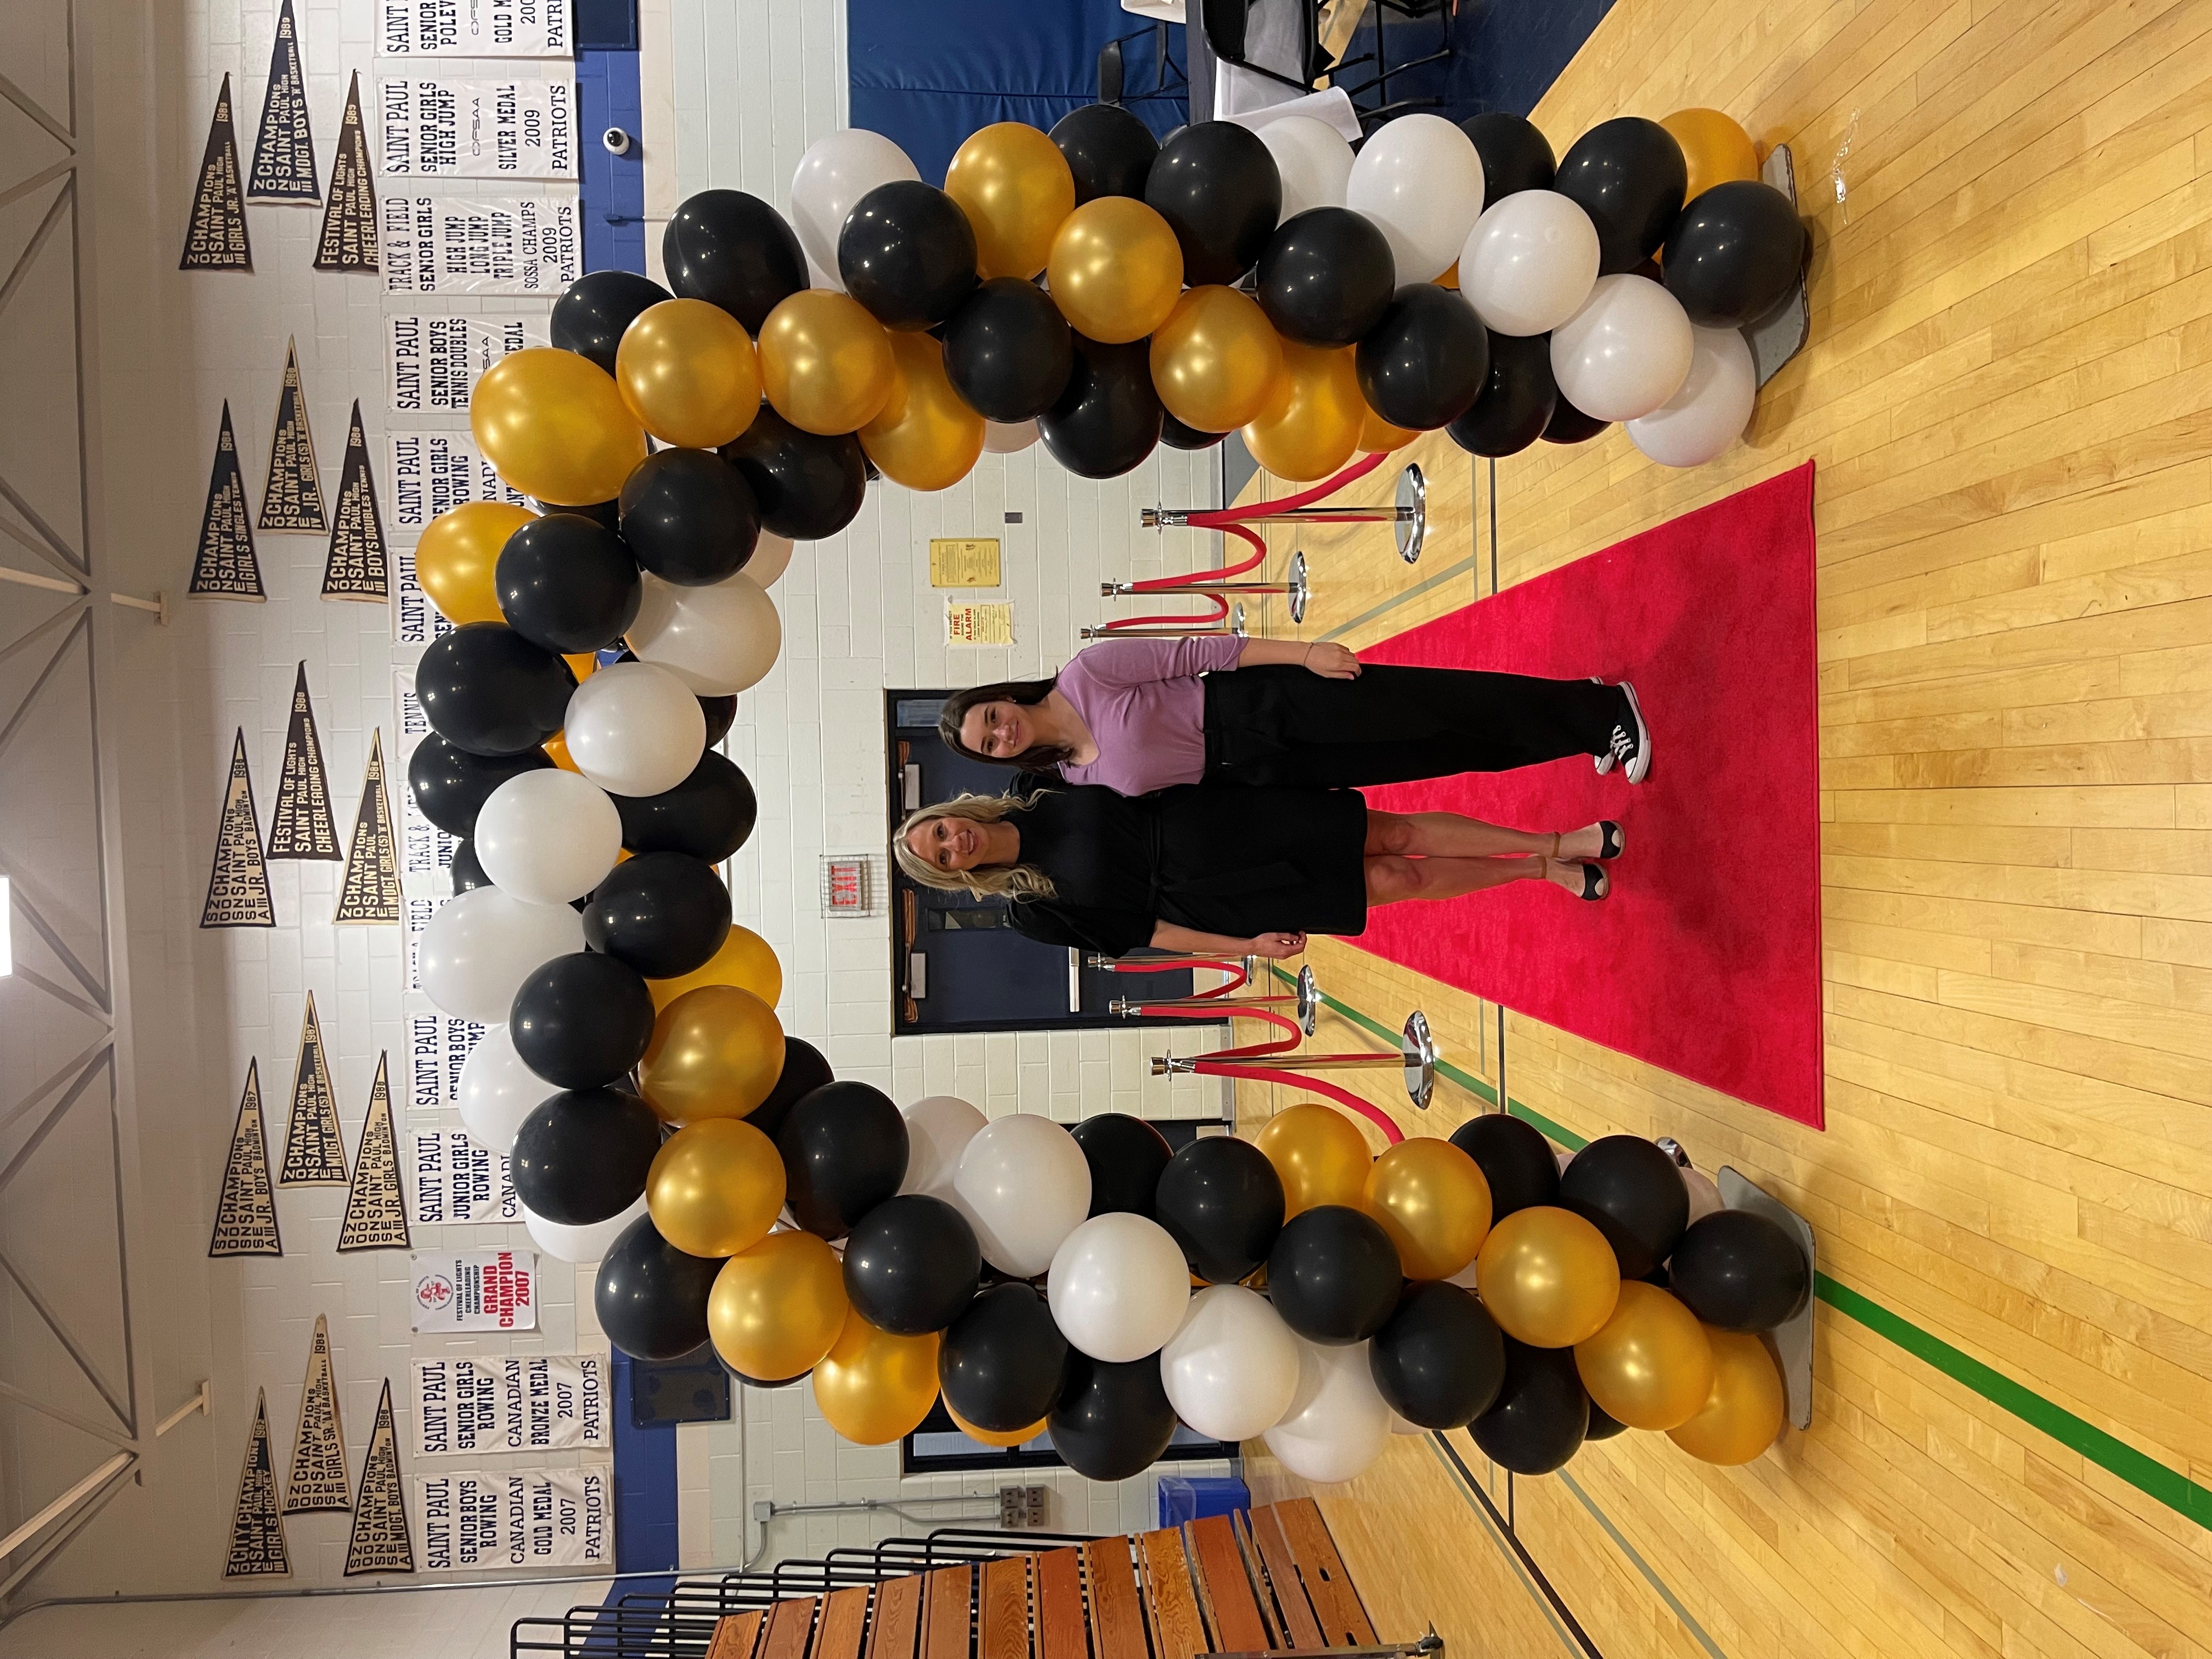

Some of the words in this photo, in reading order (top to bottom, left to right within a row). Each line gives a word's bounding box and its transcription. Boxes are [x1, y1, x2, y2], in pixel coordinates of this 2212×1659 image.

[386, 6, 410, 53] SAINT
[420, 3, 438, 49] SENIOR
[494, 14, 512, 43] GOLD
[279, 97, 290, 123] PAUL
[292, 98, 308, 139] BOYS
[386, 81, 409, 121] PAUL
[419, 83, 437, 120] GIRLS
[438, 90, 455, 126] JUMP
[496, 85, 516, 124] MEDAL
[257, 84, 281, 176] CHAMPIONS
[439, 130, 456, 165] HIGH
[524, 110, 540, 146] 2009
[550, 86, 568, 170] PATRIOTS
[275, 129, 291, 177] SAINT
[386, 126, 410, 172] SAINT
[420, 125, 438, 172] SENIOR
[498, 131, 517, 170] SILVER
[335, 154, 347, 185] LIGHTS
[191, 164, 216, 251] CHAMPIONS
[212, 178, 223, 202] PAUL
[332, 188, 343, 201] OF
[345, 190, 356, 215] PAUL
[208, 207, 224, 251] SAINT
[227, 218, 245, 251] GIRLS
[321, 204, 343, 263] FESTIVAL
[358, 178, 378, 266] CHEERLEADING
[386, 198, 410, 232] FIELD
[416, 198, 432, 238] GIRLS
[445, 216, 465, 242] JUMP
[469, 216, 489, 242] JUMP
[492, 212, 512, 239] JUMP
[521, 202, 537, 255] CHAMPS
[342, 219, 359, 264] SAINT
[446, 247, 467, 273] HIGH
[469, 247, 490, 274] LONG
[492, 242, 513, 279] TRIPLE
[542, 227, 557, 263] 2009
[558, 207, 574, 282] PATRIOTS
[387, 253, 412, 290] TRACK
[419, 241, 435, 291] SENIOR
[524, 259, 538, 289] SOSSA
[396, 318, 419, 357] PAUL
[430, 321, 448, 354] BOYS
[449, 319, 467, 368] DOUBLES
[397, 362, 420, 409] SAINT
[431, 358, 448, 405] SENIOR
[450, 370, 469, 409] TENNIS
[266, 430, 286, 514] CHAMPIONS
[286, 442, 296, 467] PAUL
[397, 437, 420, 476] PAUL
[430, 439, 448, 473] GIRLS
[285, 471, 300, 515] SAINT
[451, 456, 470, 505] ROWING
[222, 507, 232, 532] PAUL
[234, 501, 248, 542] SINGLES
[351, 504, 361, 529] PAUL
[362, 495, 377, 539] DOUBLES
[398, 480, 422, 524] SAINT
[200, 493, 223, 578] CHAMPIONS
[330, 490, 352, 578] CHAMPIONS
[219, 535, 235, 579] SAINT
[238, 545, 256, 580] GIRLS
[348, 533, 364, 578] SAINT
[366, 541, 385, 576] BOYS
[401, 596, 424, 642] SAINT
[285, 742, 296, 775] LIGHTS
[303, 718, 317, 764] CHAMPIONS
[284, 777, 295, 790] OF
[297, 778, 308, 804] PAUL
[273, 793, 294, 853] FESTIVAL
[310, 767, 333, 853] CHEERLEADING
[234, 821, 244, 845] PAUL
[295, 809, 311, 852] SAINT
[365, 834, 376, 859] PAUL
[213, 809, 234, 896] CHAMPIONS
[246, 839, 260, 866] BOYS
[345, 821, 368, 905] CHAMPIONS
[379, 848, 393, 871] GIRLS
[409, 836, 431, 872] TRACK
[231, 851, 246, 895] SAINT
[363, 863, 379, 905] SAINT
[831, 866, 857, 905] EXIT
[414, 1016, 437, 1054] PAUL
[448, 1019, 465, 1051] BOYS
[244, 1091, 257, 1110] 1987
[415, 1060, 439, 1105] SAINT
[287, 1083, 307, 1166] CHAMPIONS
[308, 1094, 317, 1120] PAUL
[320, 1109, 334, 1133] GIRLS
[242, 1150, 252, 1174] PAUL
[305, 1124, 321, 1166] SAINT
[371, 1144, 381, 1169] PAUL
[417, 1133, 441, 1172] PAUL
[452, 1133, 469, 1169] GIRLS
[221, 1137, 244, 1223] CHAMPIONS
[254, 1168, 268, 1194] BOYS
[350, 1131, 373, 1218] CHAMPIONS
[383, 1160, 396, 1190] GIRLS
[472, 1150, 489, 1201] ROWING
[239, 1180, 254, 1223] SAINT
[368, 1176, 383, 1218] SAINT
[419, 1177, 442, 1222] SAINT
[453, 1173, 470, 1219] JUNIOR
[483, 1266, 498, 1314] GRAND
[498, 1252, 514, 1327] CHAMPION
[515, 1271, 529, 1307] 2007
[422, 1362, 446, 1402] PAUL
[456, 1362, 475, 1398] GIRLS
[529, 1359, 549, 1397] MEDAL
[477, 1378, 494, 1430] ROWING
[506, 1360, 522, 1447] CANADIAN
[557, 1383, 573, 1418] 2007
[581, 1360, 599, 1440] PATRIOTS
[294, 1389, 314, 1481] CHAMPIONS
[424, 1407, 447, 1452] SAINT
[458, 1403, 475, 1448] SENIOR
[531, 1401, 549, 1444] BRONZE
[311, 1435, 324, 1481] SAINT
[325, 1443, 343, 1479] GIRLS
[238, 1440, 259, 1523] CHAMPIONS
[264, 1470, 275, 1514] HOCKEY
[356, 1455, 377, 1542] CHAMPIONS
[376, 1468, 386, 1492] PAUL
[385, 1483, 399, 1505] BOYS
[426, 1479, 449, 1518] PAUL
[460, 1481, 477, 1512] BOYS
[253, 1489, 263, 1514] PAUL
[373, 1498, 387, 1542] SAINT
[509, 1477, 524, 1564] CANADIAN
[533, 1482, 551, 1520] MEDAL
[560, 1498, 575, 1534] 2007
[585, 1476, 601, 1559] PATRIOTS
[250, 1519, 264, 1560] SAINT
[266, 1517, 283, 1559] GIRLS
[460, 1515, 477, 1563] SENIOR
[479, 1495, 497, 1548] ROWING
[533, 1526, 552, 1555] GOLD
[230, 1528, 250, 1561] CITY
[427, 1522, 450, 1568] SAINT
